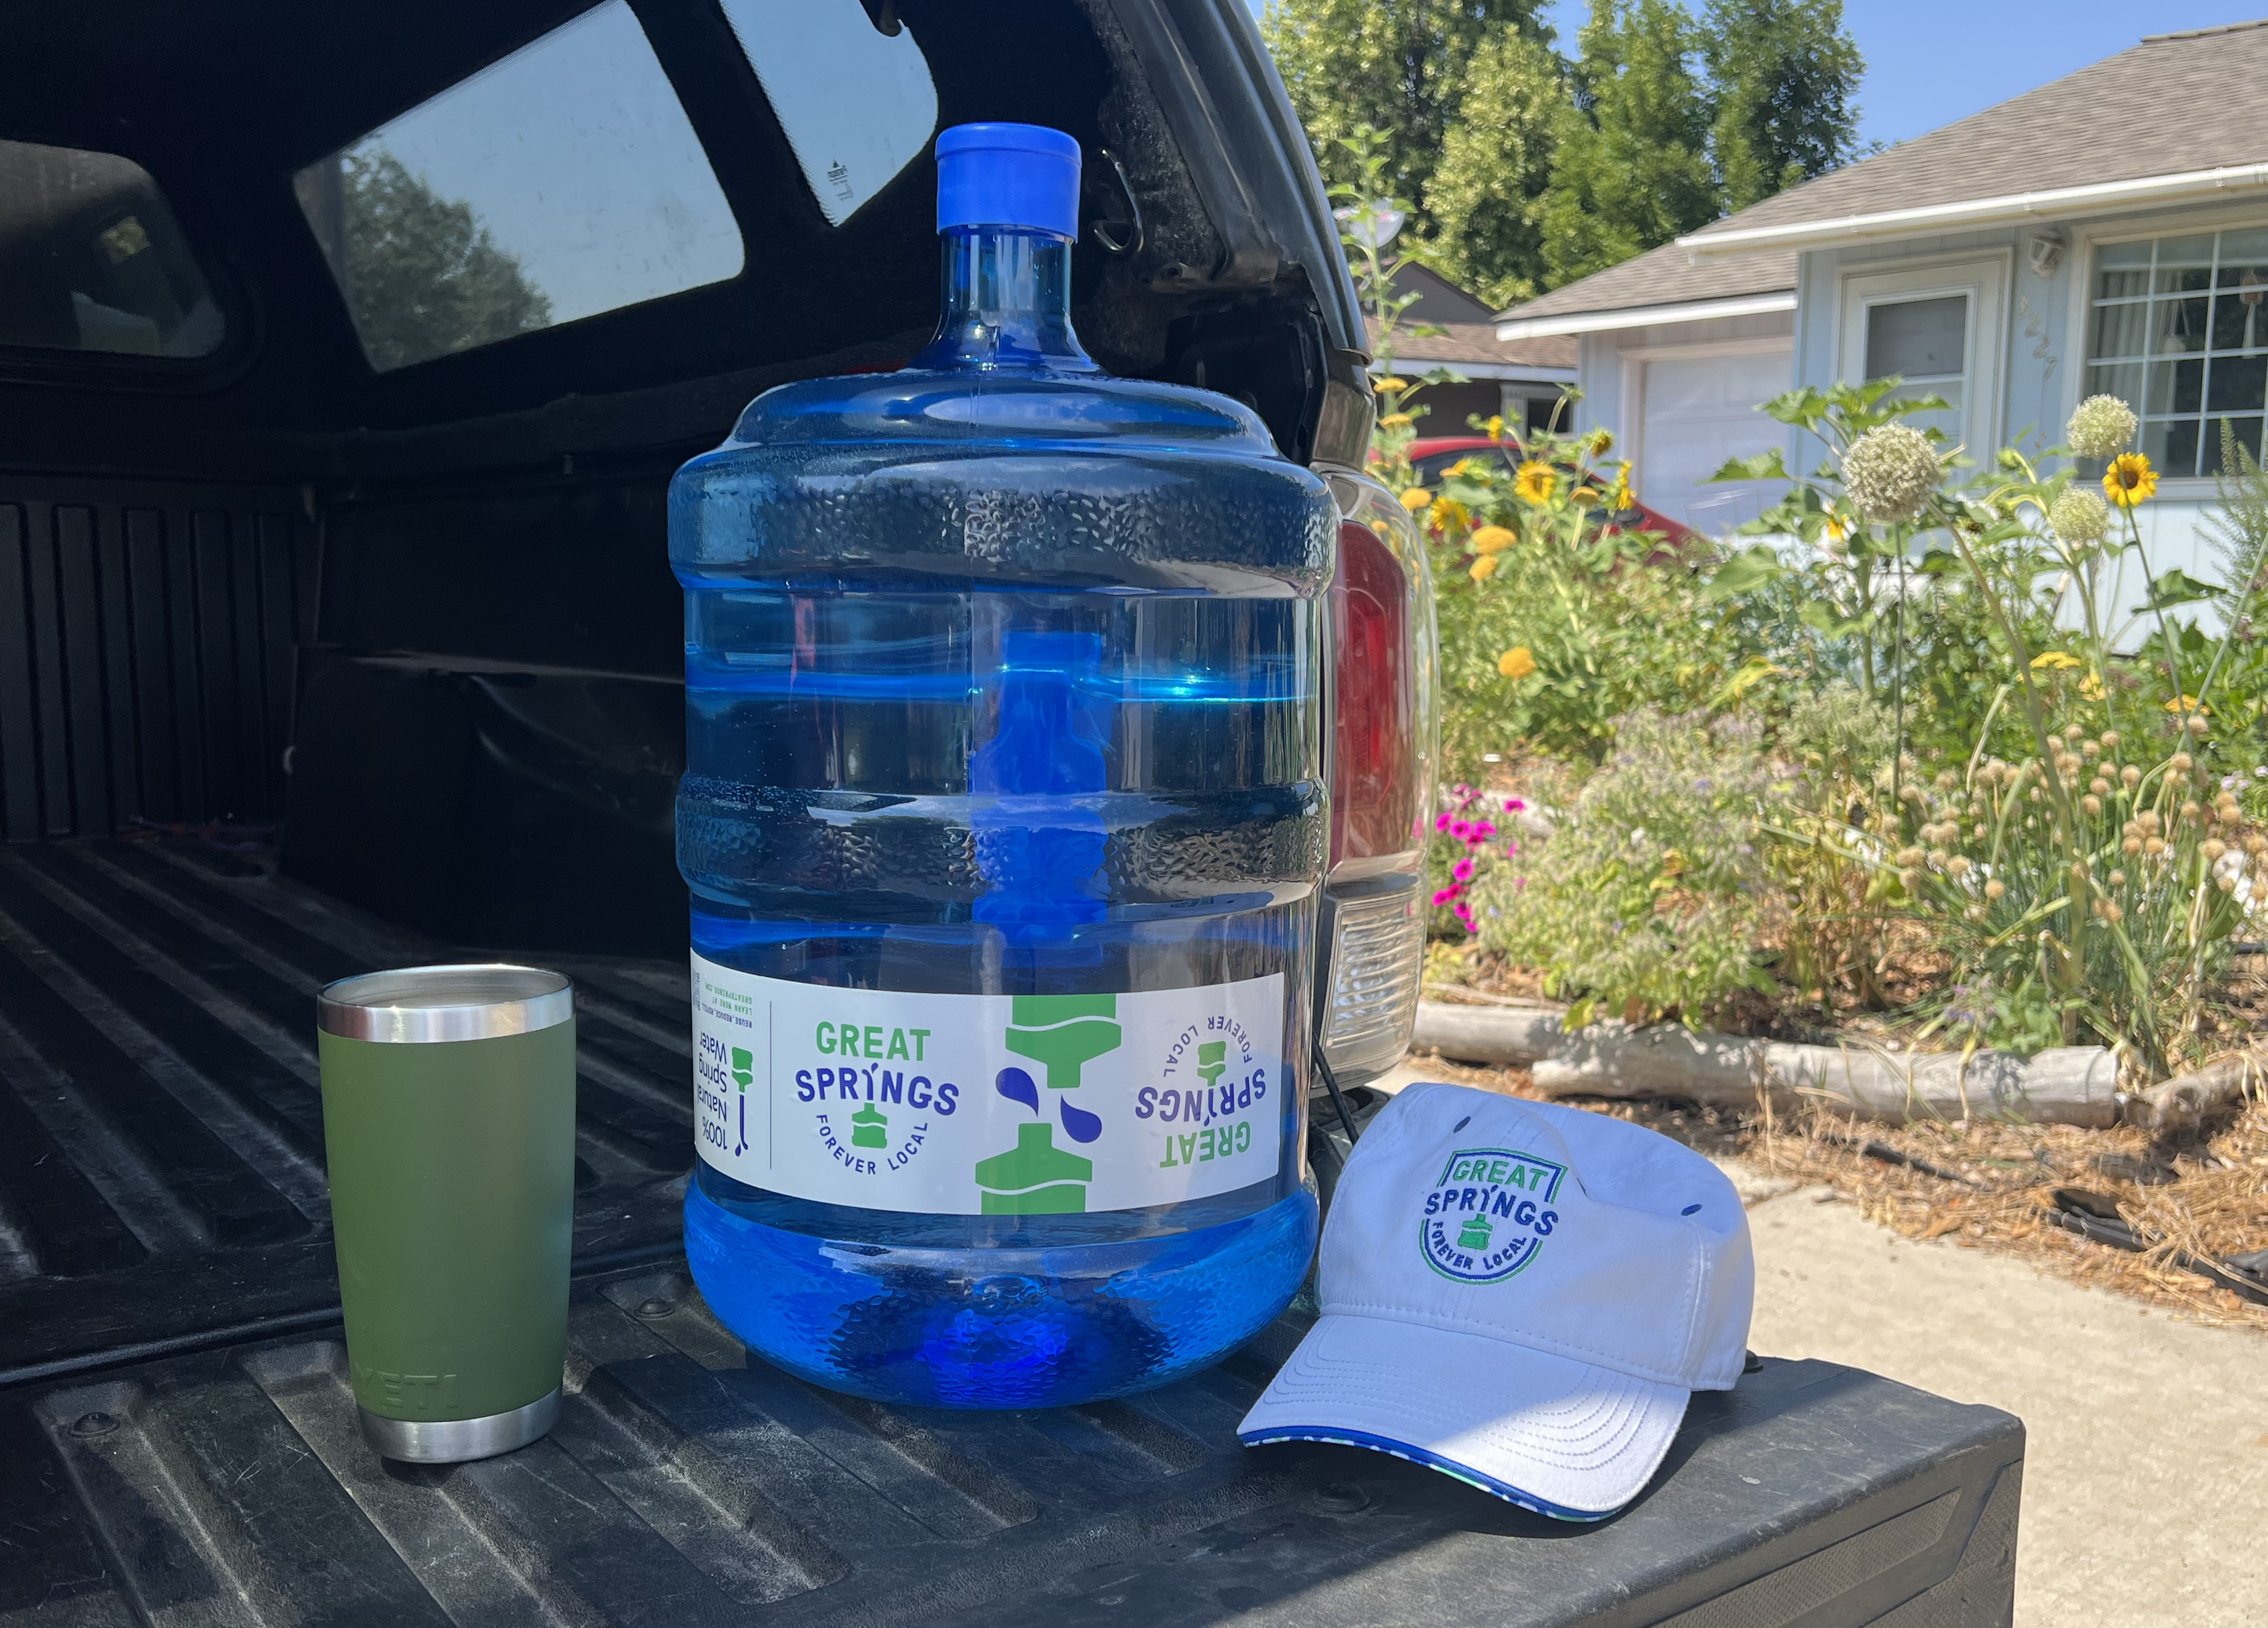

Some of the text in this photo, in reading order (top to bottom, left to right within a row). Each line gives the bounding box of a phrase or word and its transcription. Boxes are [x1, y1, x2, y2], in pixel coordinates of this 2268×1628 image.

[719, 998, 732, 1010] MORE
[735, 1004, 752, 1015] LEARN
[699, 1031, 727, 1066] Water
[815, 1021, 931, 1062] GREAT
[1163, 1015, 1253, 1078] FOREVER LOCAL
[699, 1053, 727, 1094] Spring
[795, 1062, 960, 1116] SPRINGS
[697, 1084, 727, 1122] Natural
[1135, 1068, 1266, 1127] SPRINGS
[703, 1116, 728, 1150] 100%
[815, 1114, 928, 1175] FOREVER LOCAL
[1160, 1121, 1251, 1168] GREAT
[1452, 1158, 1549, 1192] GREAT
[1423, 1184, 1559, 1237] SPRINGS
[1431, 1220, 1527, 1271] FOREVER LOCAL
[354, 1362, 459, 1409] YETI
